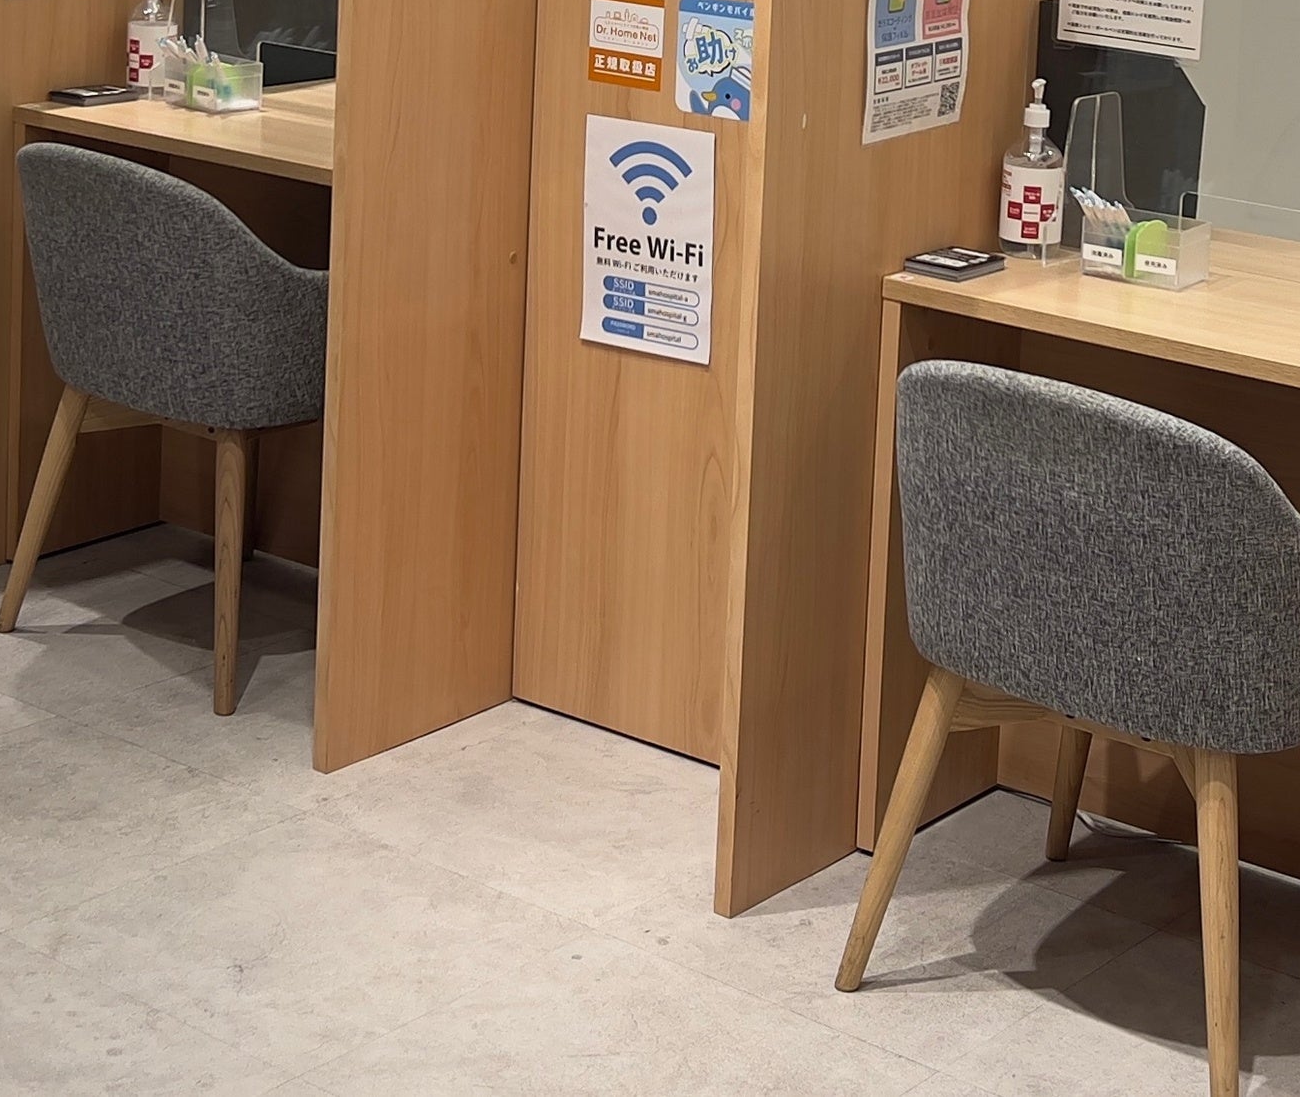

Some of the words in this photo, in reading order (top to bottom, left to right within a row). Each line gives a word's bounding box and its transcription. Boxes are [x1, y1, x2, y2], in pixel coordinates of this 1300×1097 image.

[596, 24, 609, 35] Dr.
[610, 27, 638, 39] Home
[640, 32, 656, 42] Net
[594, 54, 656, 77] 正規取扱店
[594, 227, 641, 255] Free
[647, 235, 704, 267] Wi-Fi
[613, 278, 634, 290] SSID
[613, 296, 634, 308] SSID
